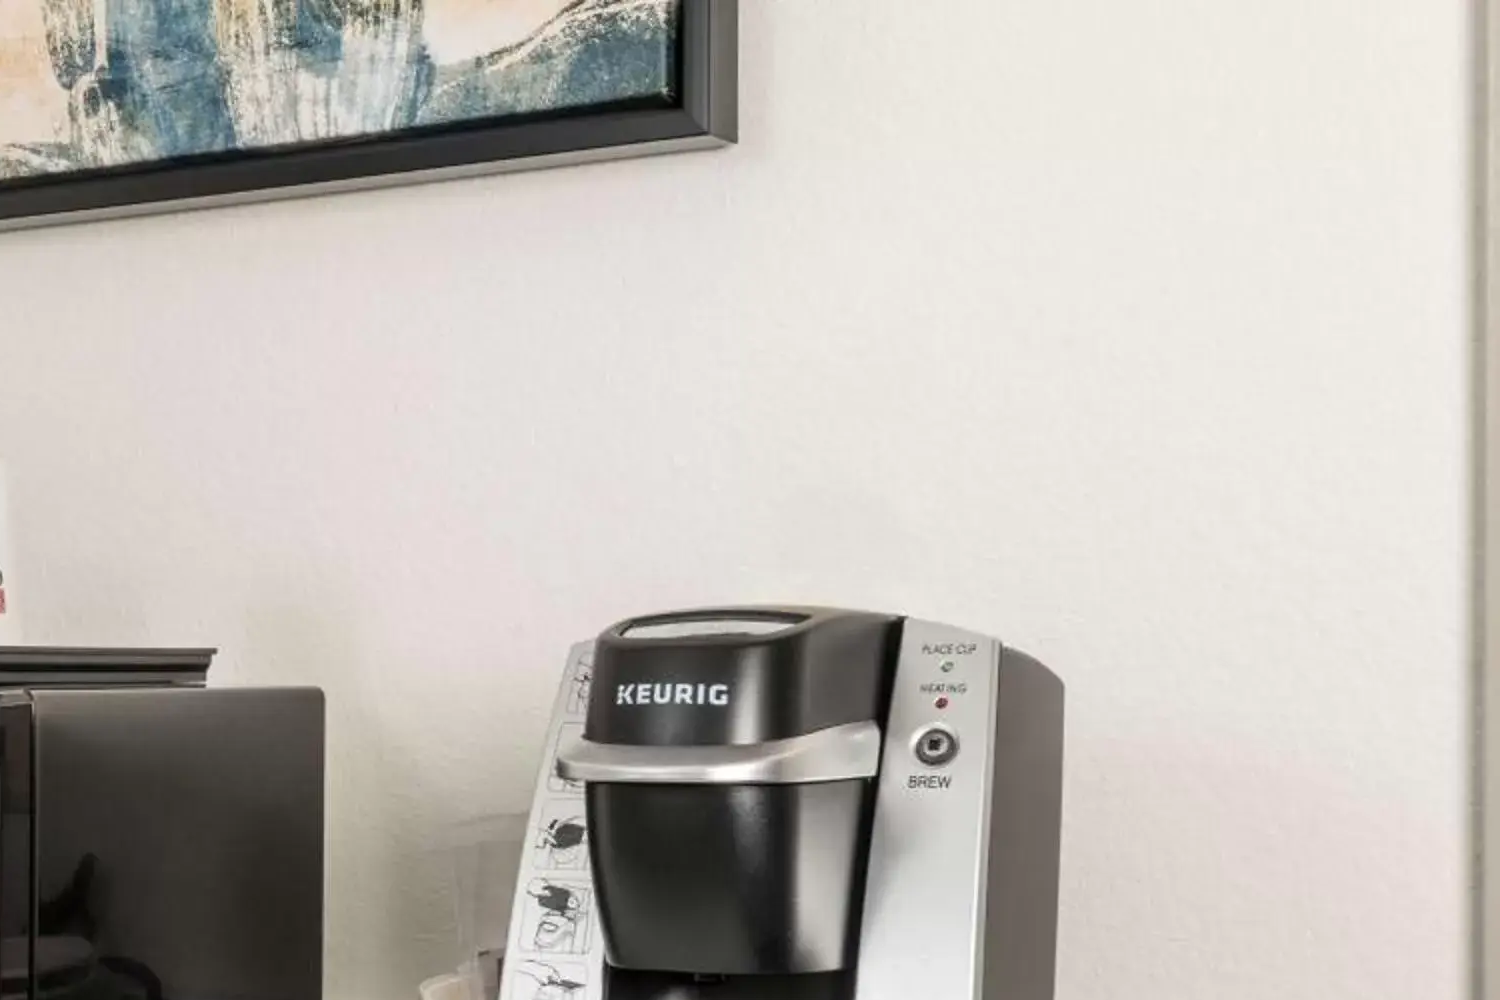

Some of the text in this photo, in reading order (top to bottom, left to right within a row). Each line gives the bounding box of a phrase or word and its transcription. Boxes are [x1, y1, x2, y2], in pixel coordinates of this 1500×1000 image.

[921, 643, 977, 655] PLACE CUP
[615, 683, 729, 706] KEURIG
[907, 775, 953, 790] BREW
